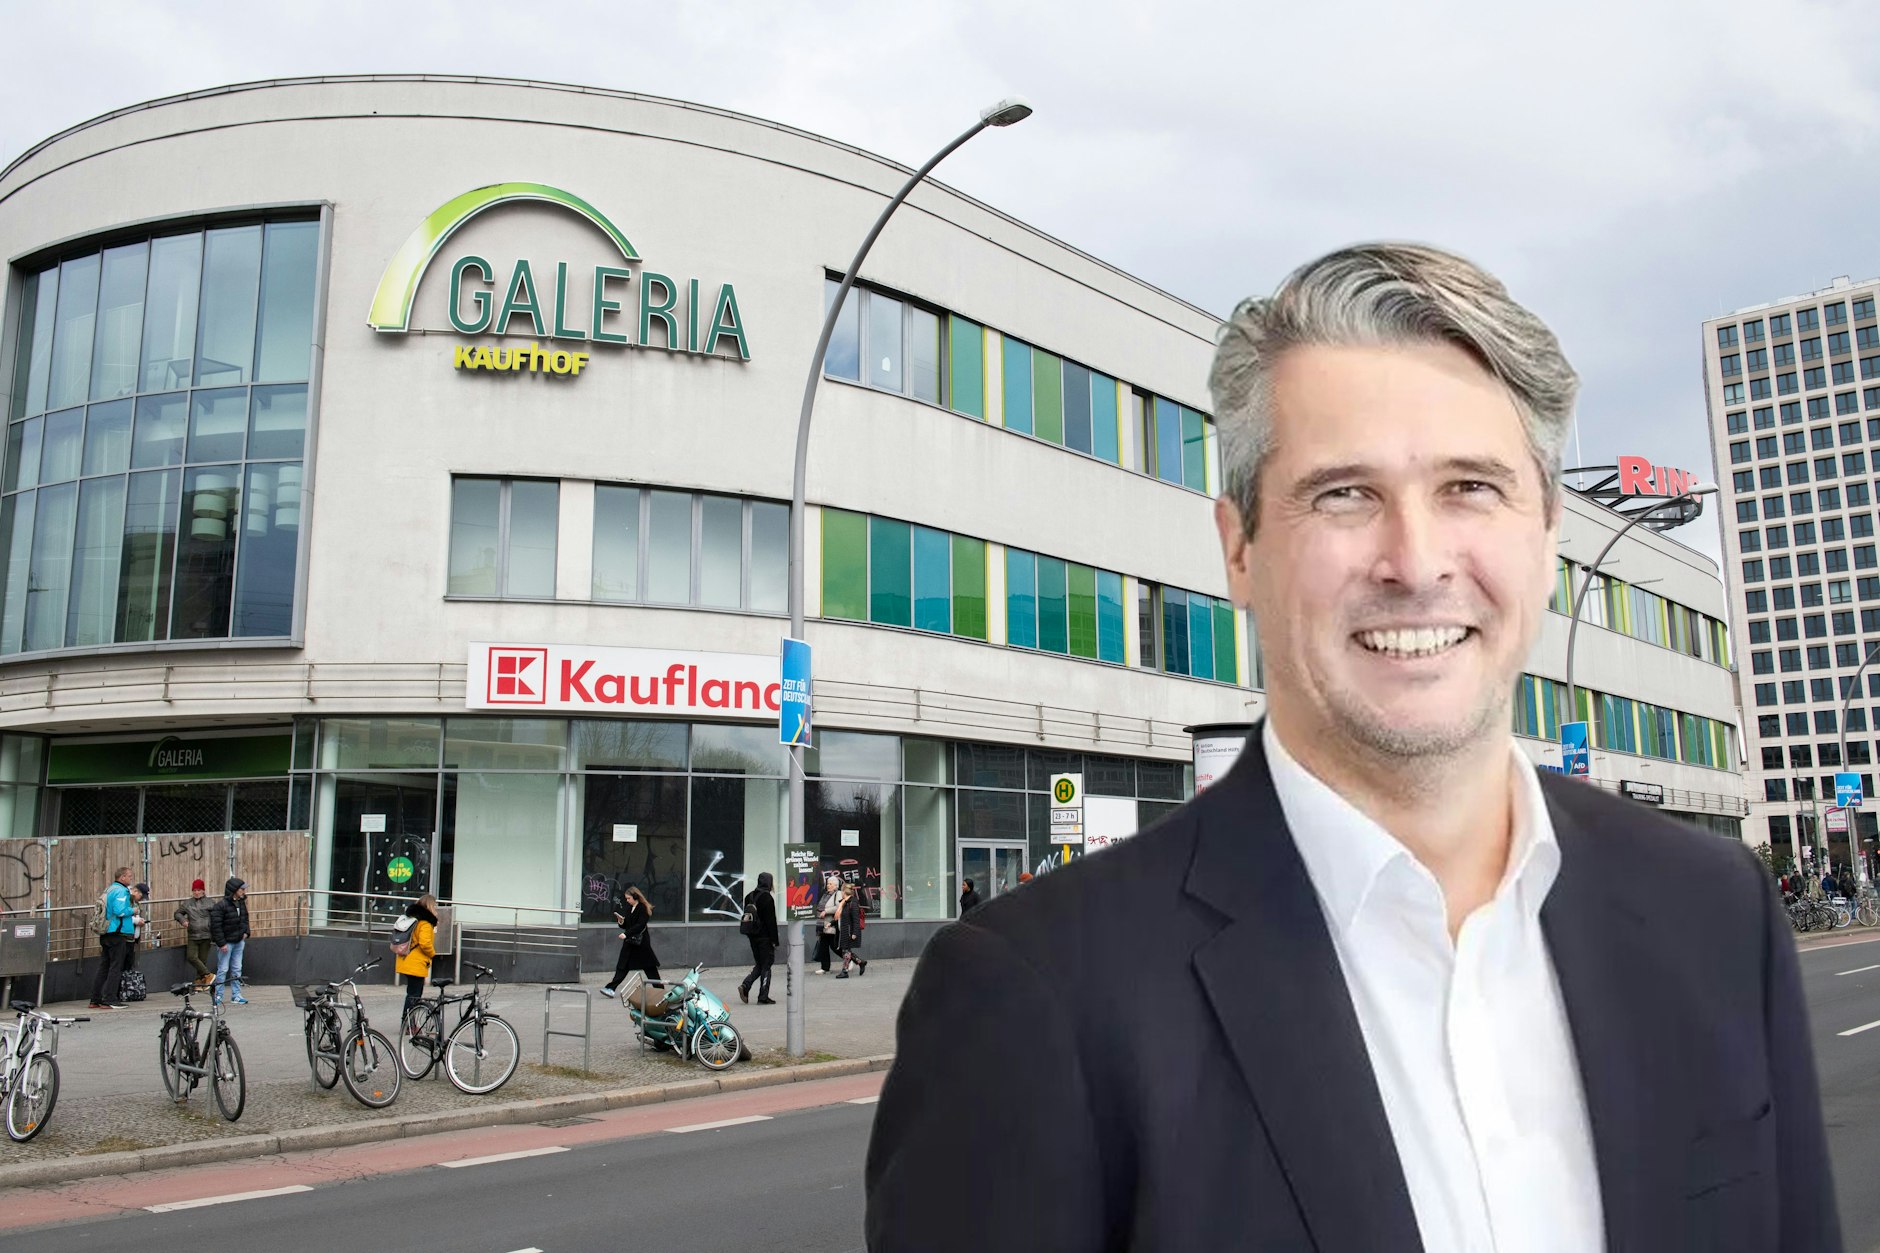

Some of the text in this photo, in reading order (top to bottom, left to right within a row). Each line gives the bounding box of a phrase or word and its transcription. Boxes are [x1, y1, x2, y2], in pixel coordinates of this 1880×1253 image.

[448, 255, 752, 362] GALERIA
[783, 679, 796, 690] ZEIT
[158, 749, 203, 767] GALERIA
[1059, 784, 1069, 798] H
